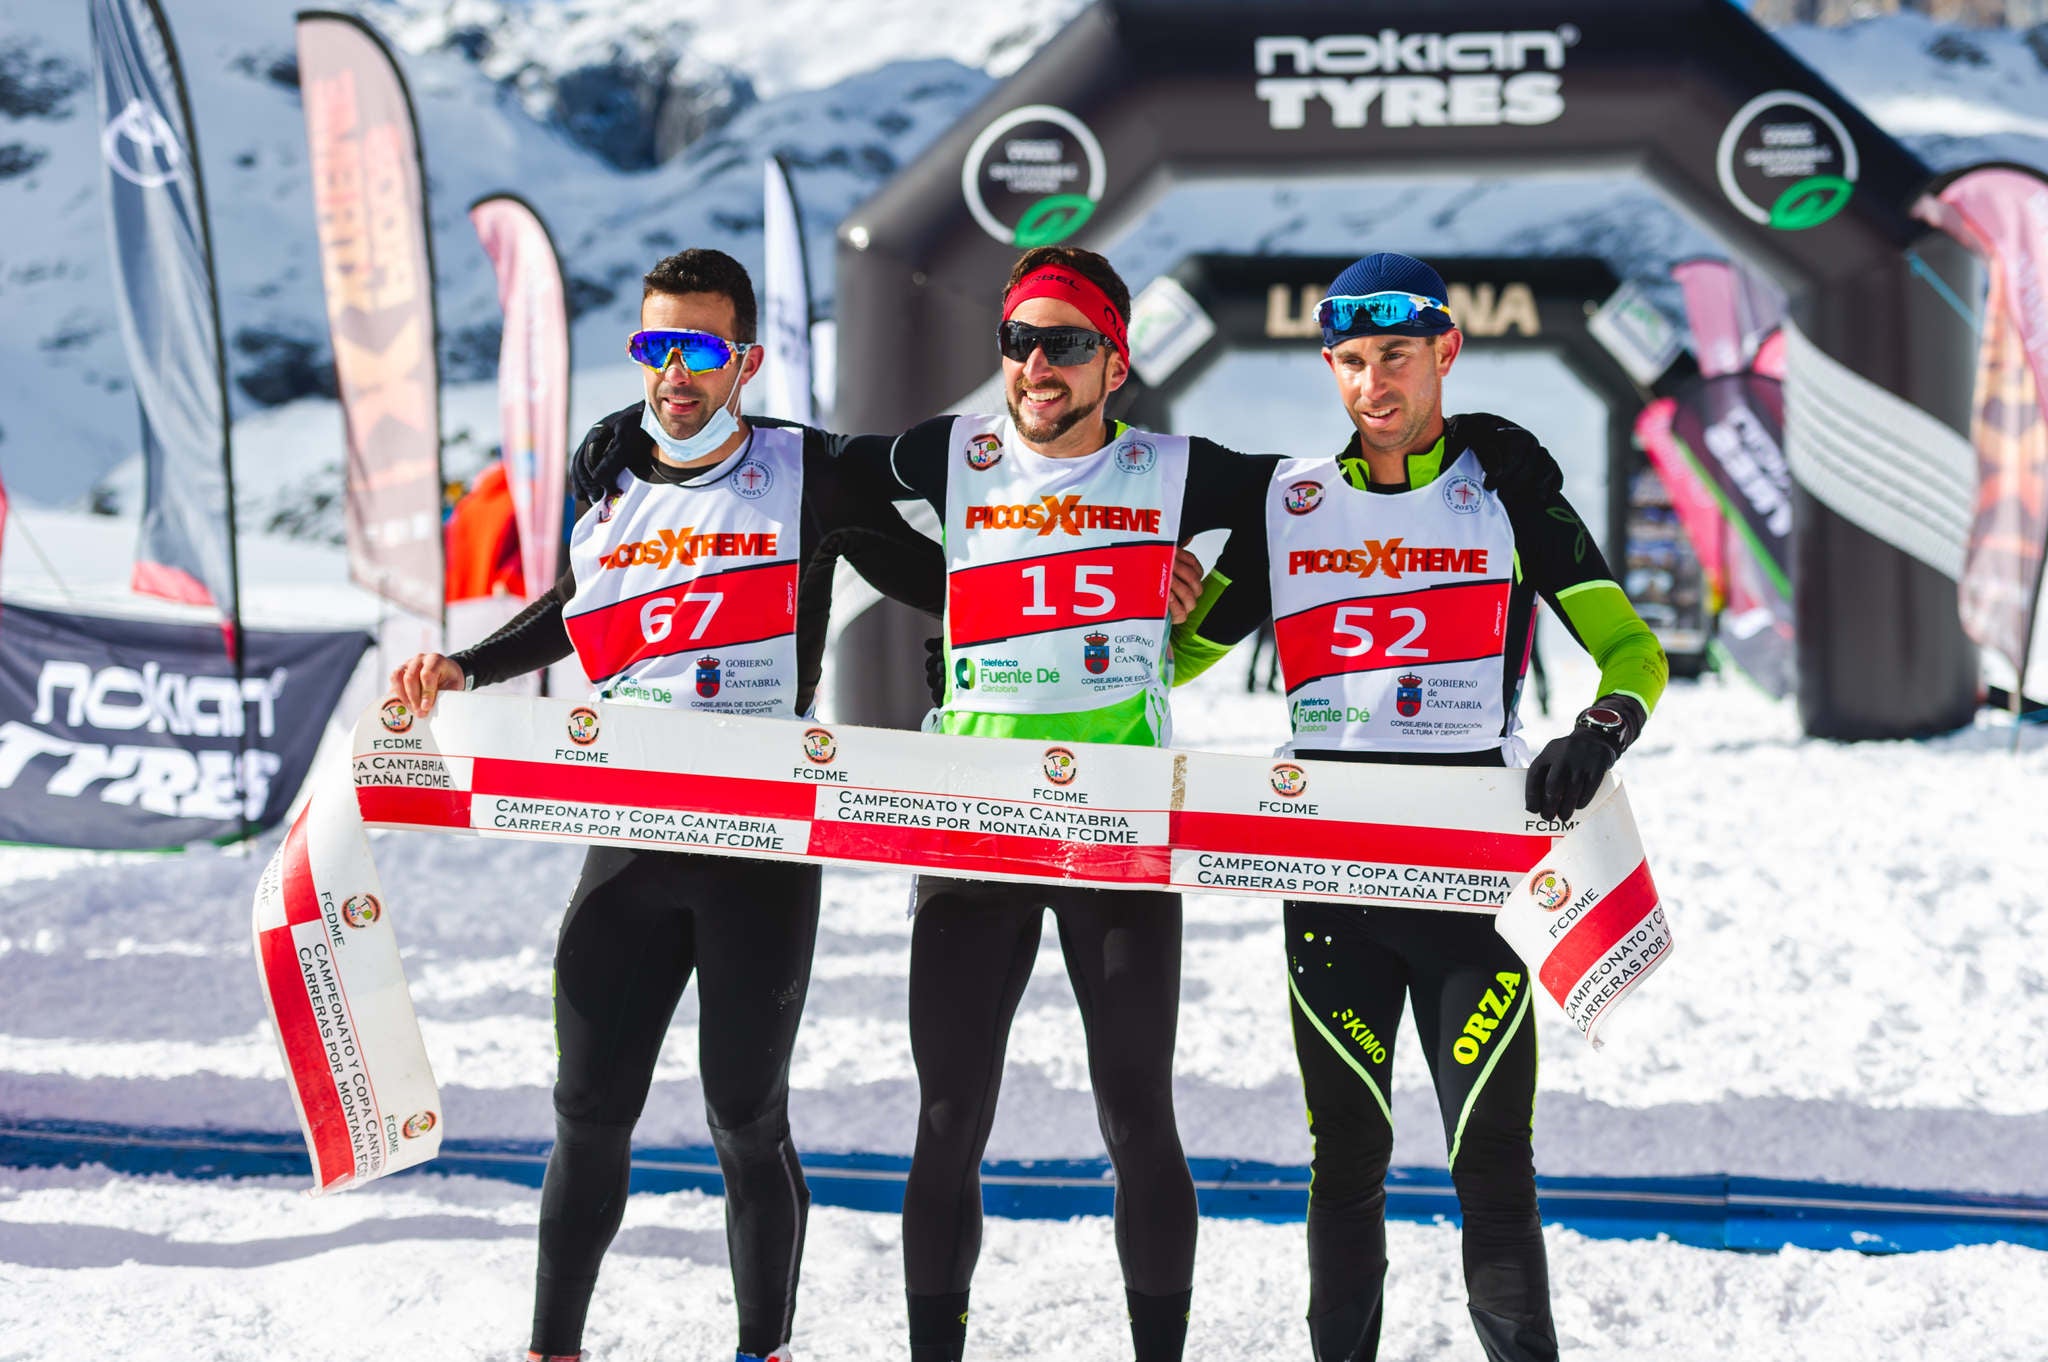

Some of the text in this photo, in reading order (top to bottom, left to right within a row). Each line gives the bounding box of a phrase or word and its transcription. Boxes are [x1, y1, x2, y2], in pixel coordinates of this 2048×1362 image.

[1255, 70, 1566, 130] TYRES
[599, 526, 777, 570] COSXTREME
[1021, 565, 1117, 617] 15
[639, 591, 725, 644] 67
[1330, 605, 1429, 658] 52
[1114, 645, 1125, 653] de
[725, 658, 774, 668] GOBIERNO
[980, 657, 1019, 668] Teleférico
[725, 669, 736, 678] de
[980, 667, 1061, 684] Fuente Dé
[725, 678, 782, 689] CANTABRIA
[1428, 678, 1478, 689] GOBIERNO
[651, 687, 673, 704] Dé
[1428, 688, 1438, 697] de
[1427, 700, 1482, 710] CANTABRIA
[1299, 706, 1370, 723] Fuente Dé
[1390, 720, 1432, 728] CONSEJERÍA
[1402, 728, 1433, 736] CULTURA
[373, 738, 423, 750] FCDME
[372, 757, 445, 772] CANTABRIA
[555, 749, 609, 763] FCDME
[406, 772, 450, 788] FCDME
[793, 767, 849, 783] FCDME
[1032, 788, 1089, 804] FCDME
[496, 799, 778, 835] CAMPEONATO Y COPA CANTABRIA
[838, 790, 1129, 828] CAMPEONATO Y COPA CANTABRIA
[1258, 801, 1319, 816] FCDME
[493, 815, 784, 851] CARRERAS POR MONTAÑA FCDME
[837, 807, 1139, 845] CARRERAS POR MONTAÑA FCDME
[1525, 820, 1580, 832] FCDM
[1198, 853, 1511, 889] CAMPEONATO Y COPA CANTABRIA
[1197, 870, 1512, 905] CARRERAS POR MONTAÑA FCDM
[320, 891, 347, 948] FCDME
[1549, 888, 1600, 939] FCDME
[1565, 930, 1648, 1020] CAMPEONATO
[1645, 920, 1655, 933] Y
[1576, 936, 1665, 1033] CARRERAS POR
[314, 943, 356, 1057] CAMPEONATO
[1452, 969, 1522, 1066] ORZA
[299, 947, 333, 1039] CARRERAS
[327, 1039, 344, 1074] POR
[338, 1081, 364, 1153] MONTAÑA
[349, 1059, 360, 1069] Y
[352, 1073, 373, 1118] COPA
